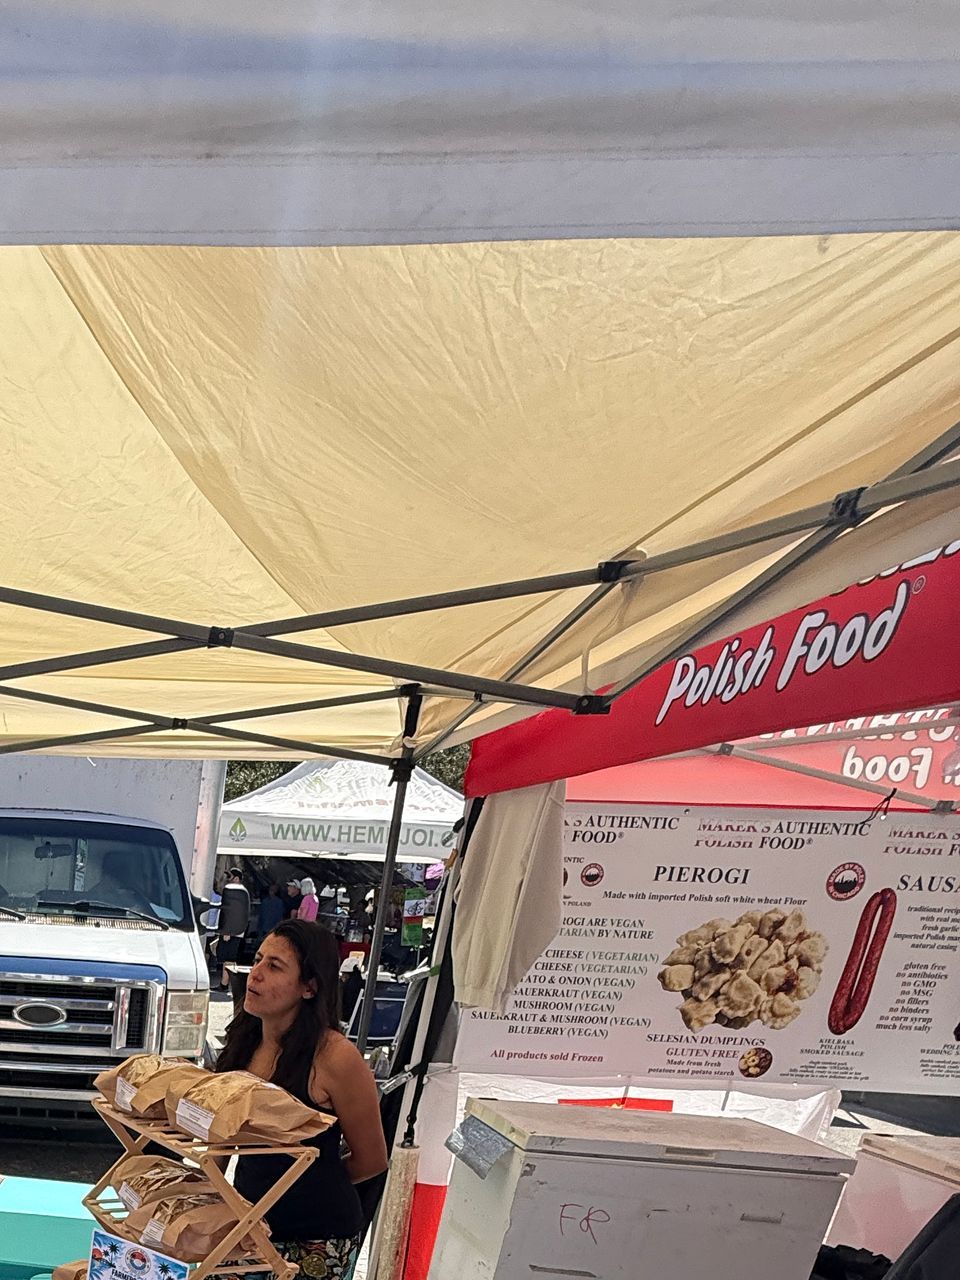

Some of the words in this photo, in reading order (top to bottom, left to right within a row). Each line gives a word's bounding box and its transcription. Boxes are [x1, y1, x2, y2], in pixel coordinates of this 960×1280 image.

[654, 626, 776, 726] Polish
[585, 815, 680, 830] AUTHENTIC
[773, 821, 872, 836] AUTHENTIC
[652, 865, 751, 885] PIEROGI
[602, 890, 626, 899] Made
[628, 892, 646, 900] with
[648, 892, 687, 903] imported
[688, 893, 713, 902] Polish
[715, 895, 731, 903] soft
[732, 896, 756, 904] white
[757, 896, 782, 905] wheat
[783, 897, 808, 906] Flour
[586, 917, 608, 927] ARE
[610, 918, 645, 928] VEGAN
[597, 929, 613, 938] BY
[613, 930, 654, 940] NATURE
[545, 949, 584, 959] CHEESE
[534, 962, 573, 972] CHEESE
[548, 975, 559, 984] &
[559, 976, 591, 986] ONION
[593, 977, 636, 989] (VEGAN)
[580, 989, 623, 1001] (VEGAN)
[512, 1000, 573, 1012] MUSHROOM
[574, 1002, 615, 1014] (VEGAN)
[539, 1013, 548, 1023] &
[549, 1013, 609, 1025] MUSHROOM
[609, 1016, 651, 1028] (VEGAN)
[507, 1025, 566, 1036] BLUEBERRY
[567, 1027, 609, 1039] (VEGAN)
[700, 1035, 766, 1046] DUMPLINGS
[490, 1049, 505, 1058] All
[506, 1050, 548, 1061] products
[549, 1051, 570, 1061] sold
[570, 1052, 604, 1063] Frozen
[666, 1047, 711, 1058] GLUTEN
[711, 1049, 739, 1059] FREE
